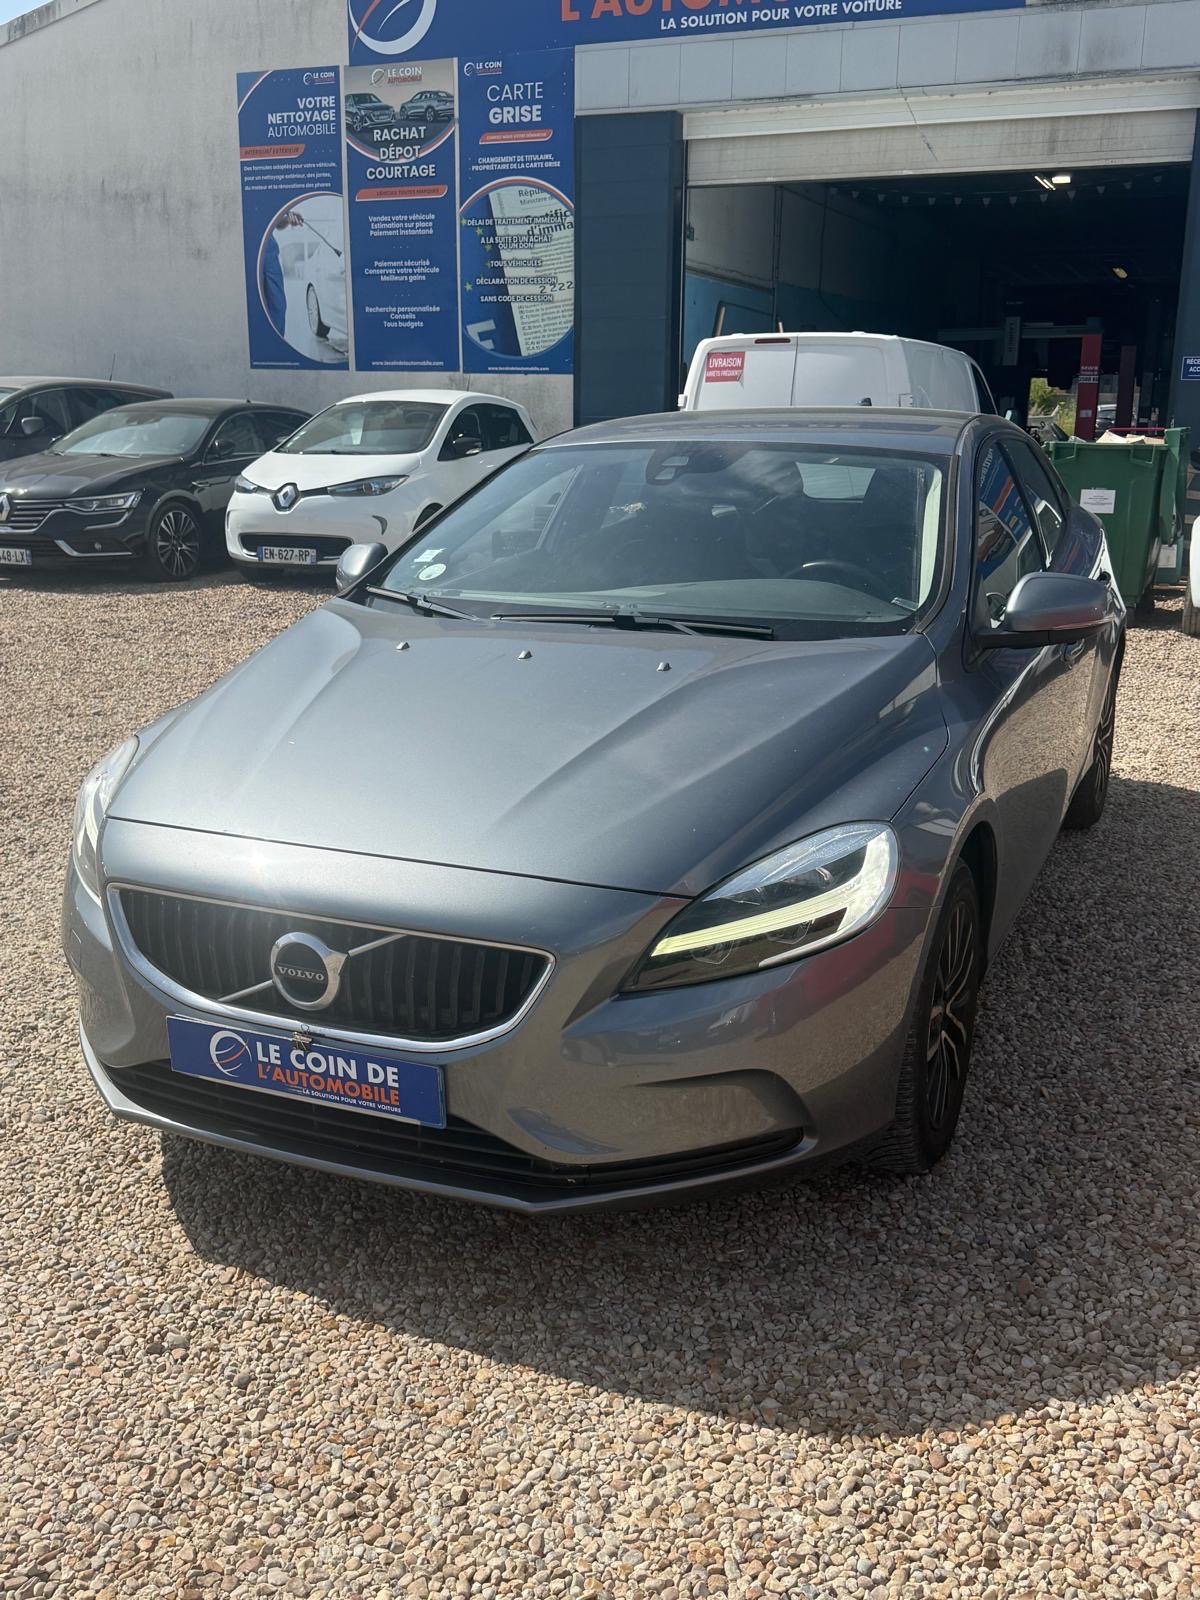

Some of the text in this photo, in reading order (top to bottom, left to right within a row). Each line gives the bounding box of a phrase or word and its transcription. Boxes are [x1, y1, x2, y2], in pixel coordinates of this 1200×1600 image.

[660, 18, 676, 30] LA
[680, 11, 747, 28] SOLUTION
[752, 8, 790, 22] POUR
[794, 3, 838, 18] VOTRE
[842, 0, 902, 14] VOITURE
[484, 60, 502, 69] COIN
[387, 66, 422, 77] LE COIN
[487, 82, 543, 102] CARTE
[297, 96, 336, 109] VOTRE
[268, 110, 336, 124] NETTOYAGE
[488, 104, 542, 124] GRISE
[268, 123, 336, 138] AUTOMOBILE
[374, 126, 426, 141] RACHAT
[380, 144, 421, 160] DÉPOT
[478, 156, 516, 164] CHANGEMENT
[366, 164, 435, 179] COURTAGE
[472, 163, 509, 171] PROPRIÉTAIRE
[415, 222, 432, 230] place
[467, 217, 485, 226] DÉLAI
[409, 274, 426, 282] gains
[476, 277, 519, 285] DÉCLARATION
[397, 305, 440, 314] personnalisée
[398, 320, 424, 328] budgets
[709, 358, 742, 368] LIVRAISON
[0, 550, 25, 563] 48-LX
[264, 548, 309, 562] EN-627-RP
[277, 966, 324, 980] VOLVO
[256, 1042, 399, 1088] LE COIN DE
[257, 1064, 400, 1105] L'AUTOMOBILE
[311, 1091, 339, 1101] SOLUTION
[378, 1104, 401, 1113] VOITURE
